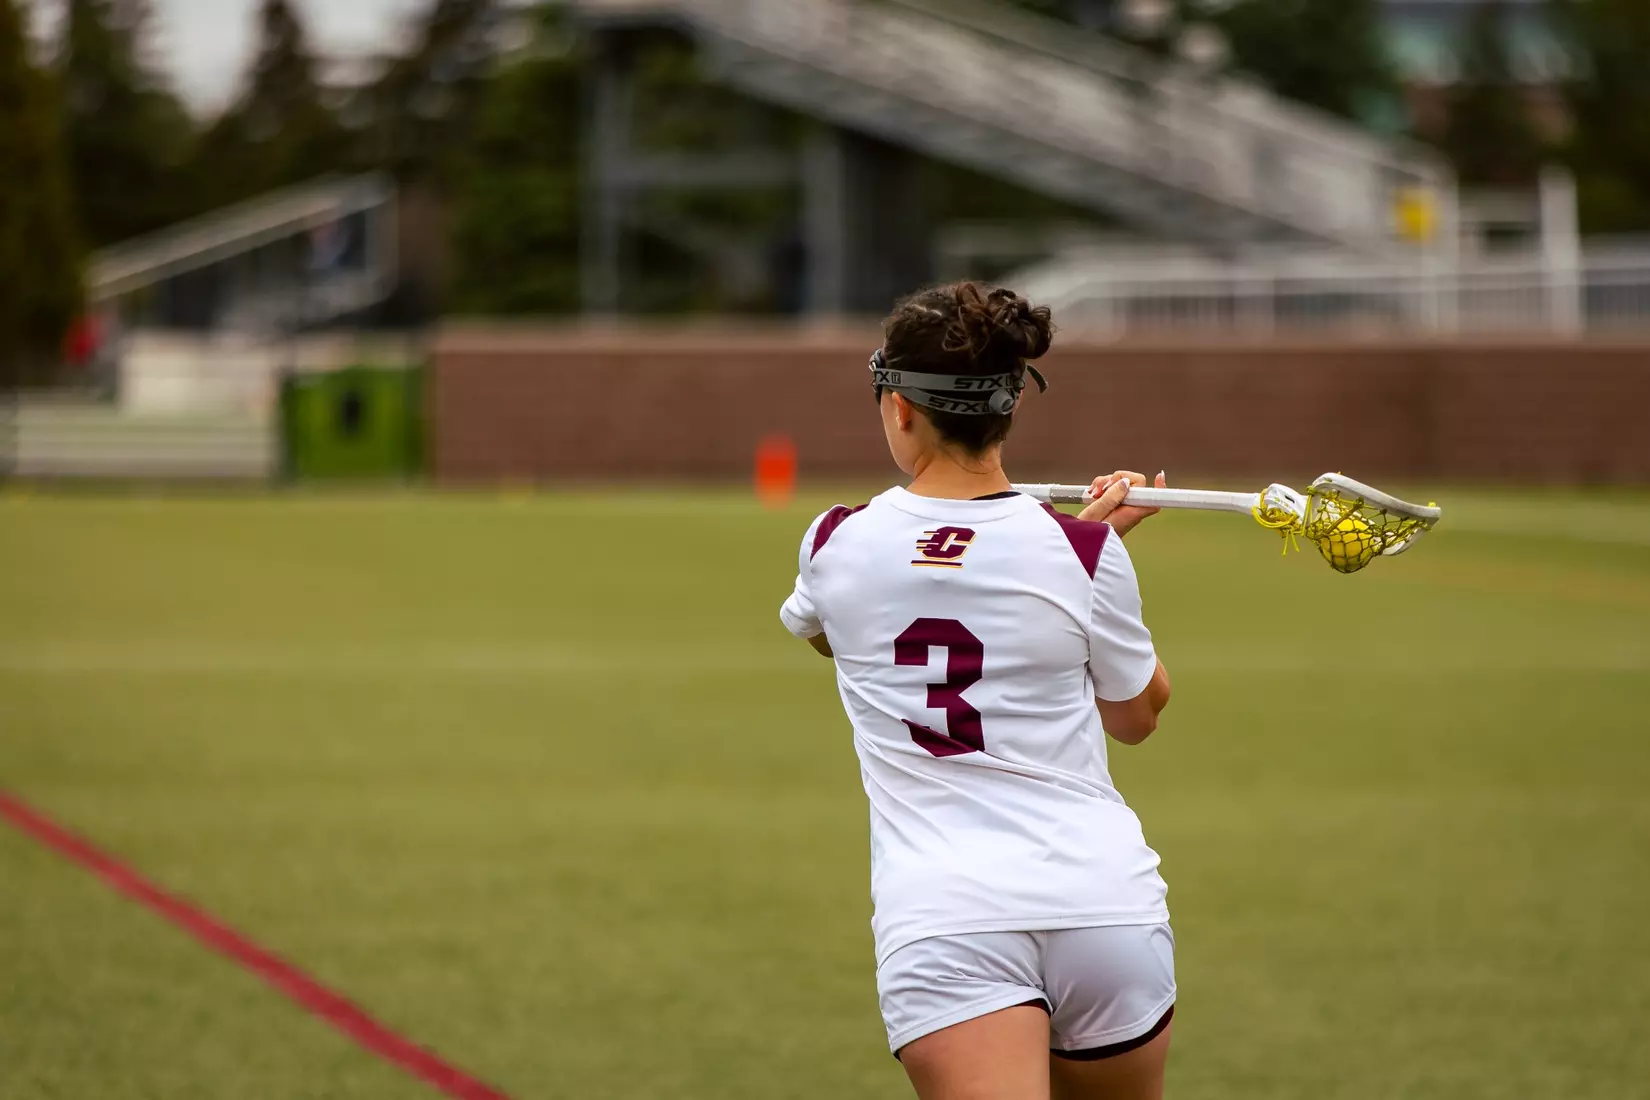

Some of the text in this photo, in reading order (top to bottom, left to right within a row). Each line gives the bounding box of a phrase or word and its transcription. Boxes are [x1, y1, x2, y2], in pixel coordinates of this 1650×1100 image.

[874, 370, 890, 384] TX
[954, 375, 1003, 390] STX
[928, 396, 979, 413] STX
[894, 618, 985, 757] 3
